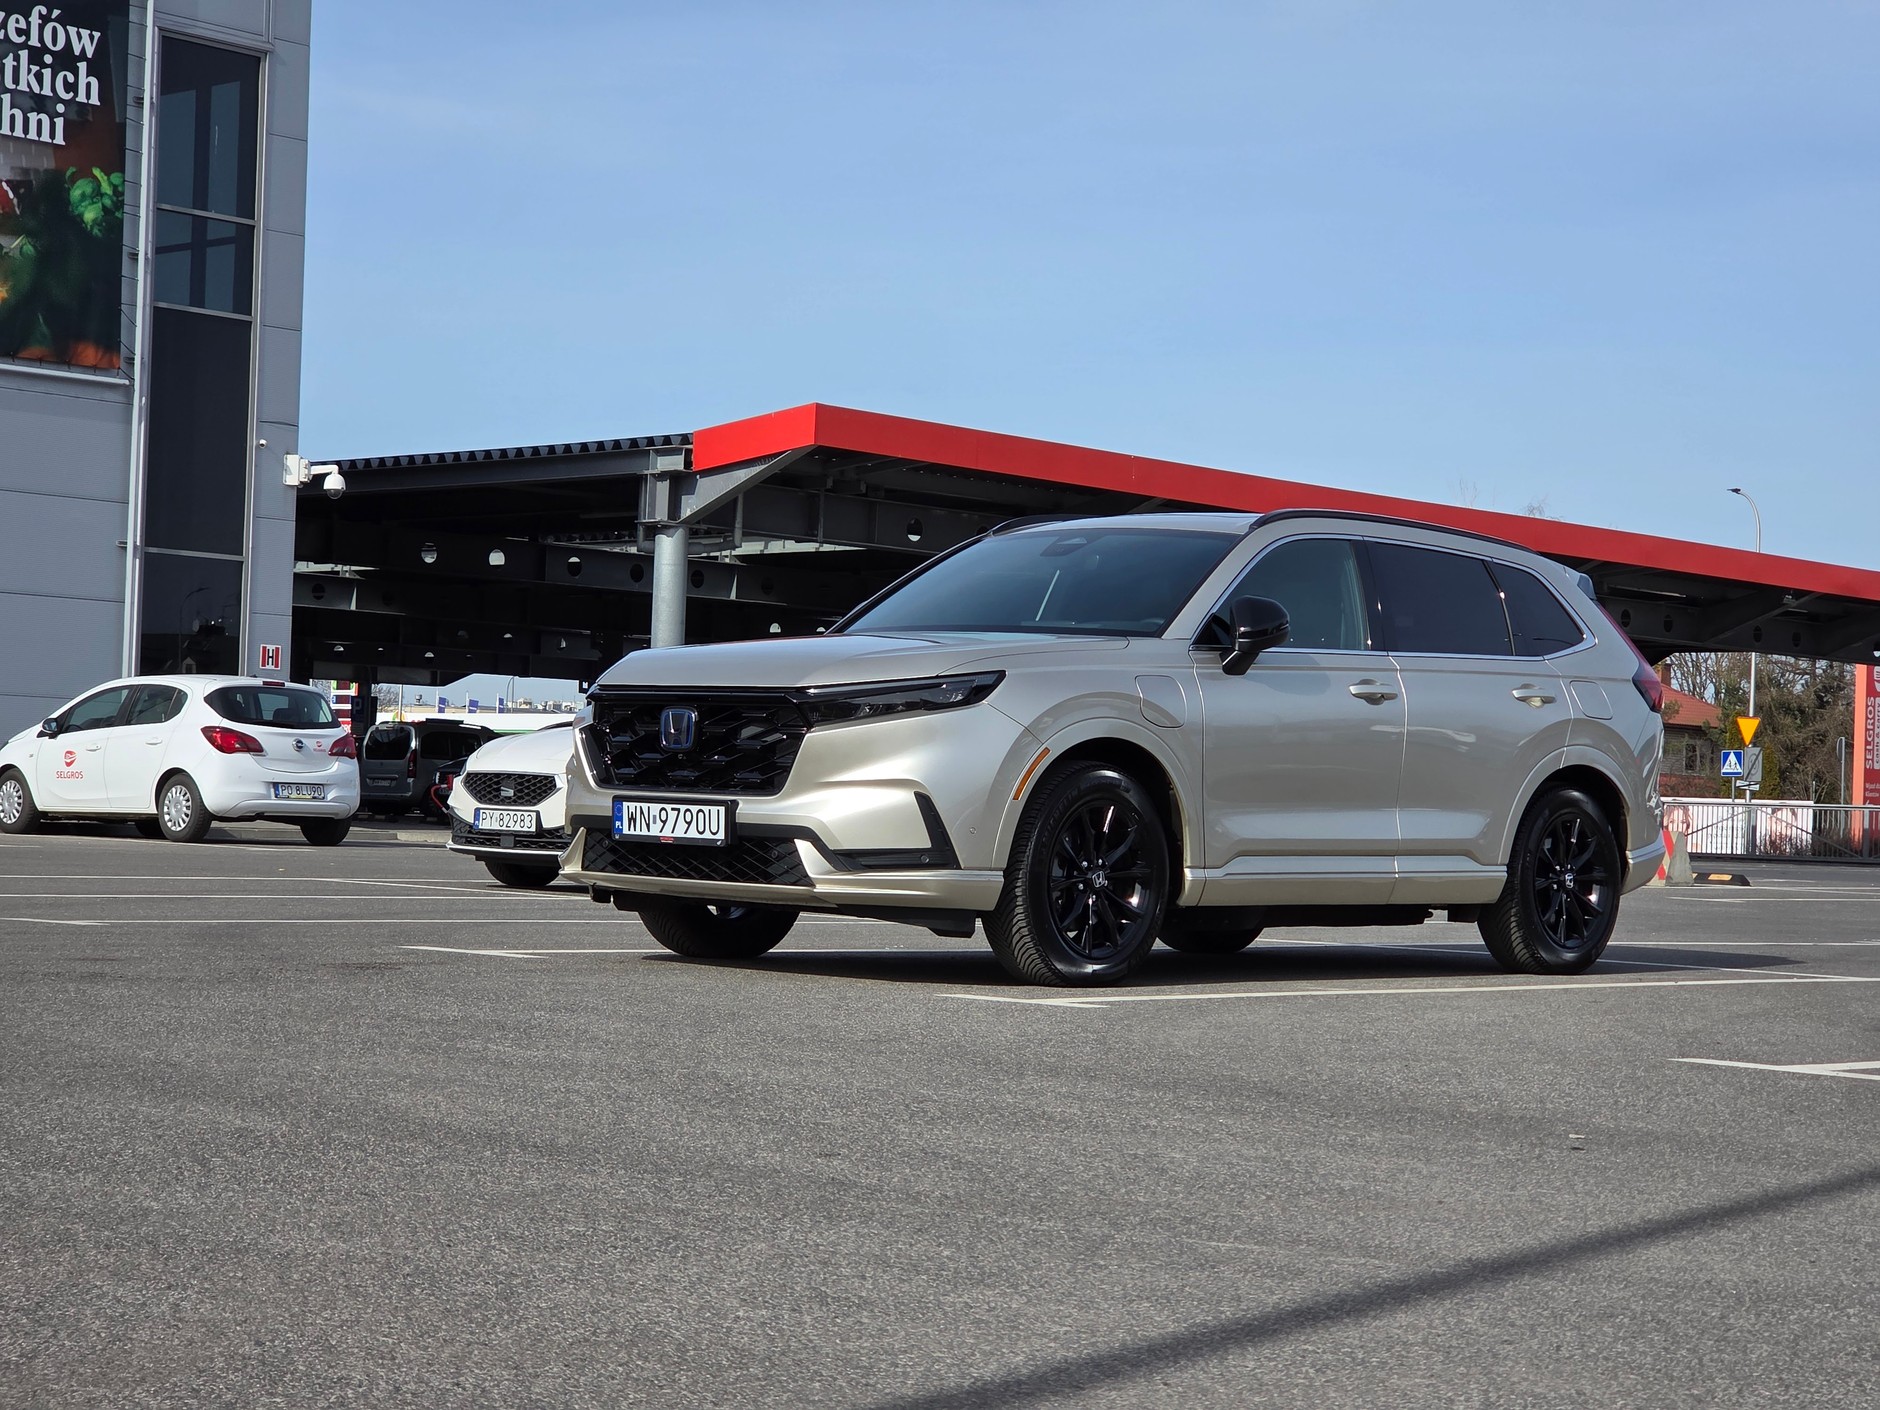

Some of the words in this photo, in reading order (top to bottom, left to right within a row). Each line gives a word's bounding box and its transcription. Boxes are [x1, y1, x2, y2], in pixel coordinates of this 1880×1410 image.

[2, 49, 101, 106] tkich
[0, 93, 66, 145] hni
[1866, 696, 1875, 769] SELGROS
[56, 770, 83, 779] SELGROS
[280, 785, 293, 795] PO
[481, 812, 494, 827] PY
[498, 812, 533, 829] 82983
[627, 805, 651, 833] WN
[658, 806, 720, 836] 9790U
